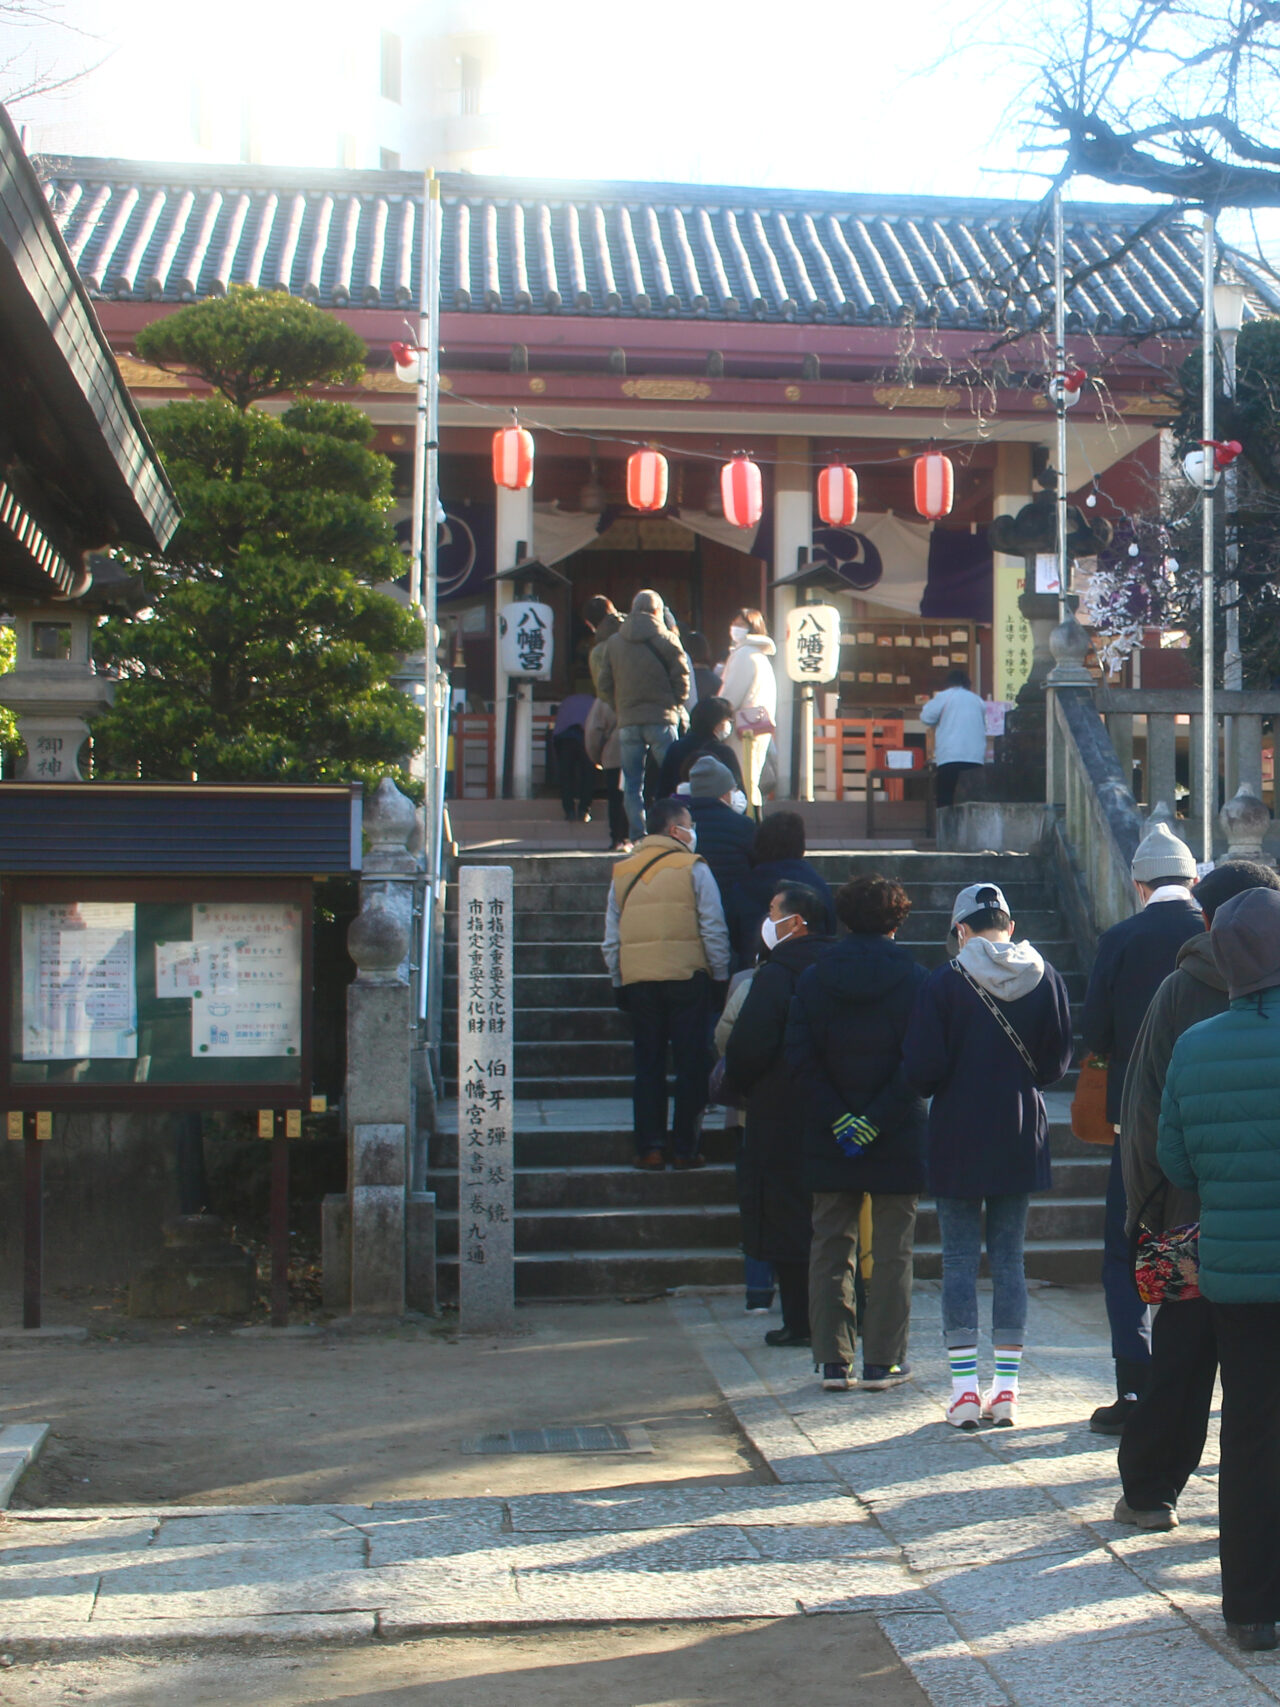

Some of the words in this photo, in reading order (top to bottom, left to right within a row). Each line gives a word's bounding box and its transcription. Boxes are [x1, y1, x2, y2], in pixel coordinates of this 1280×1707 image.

[517, 607, 546, 671] 八幡宮
[797, 613, 826, 674] 八幡宮
[467, 898, 485, 1034] 市指定重要文化財
[487, 897, 506, 1034] 市指定重要文化財
